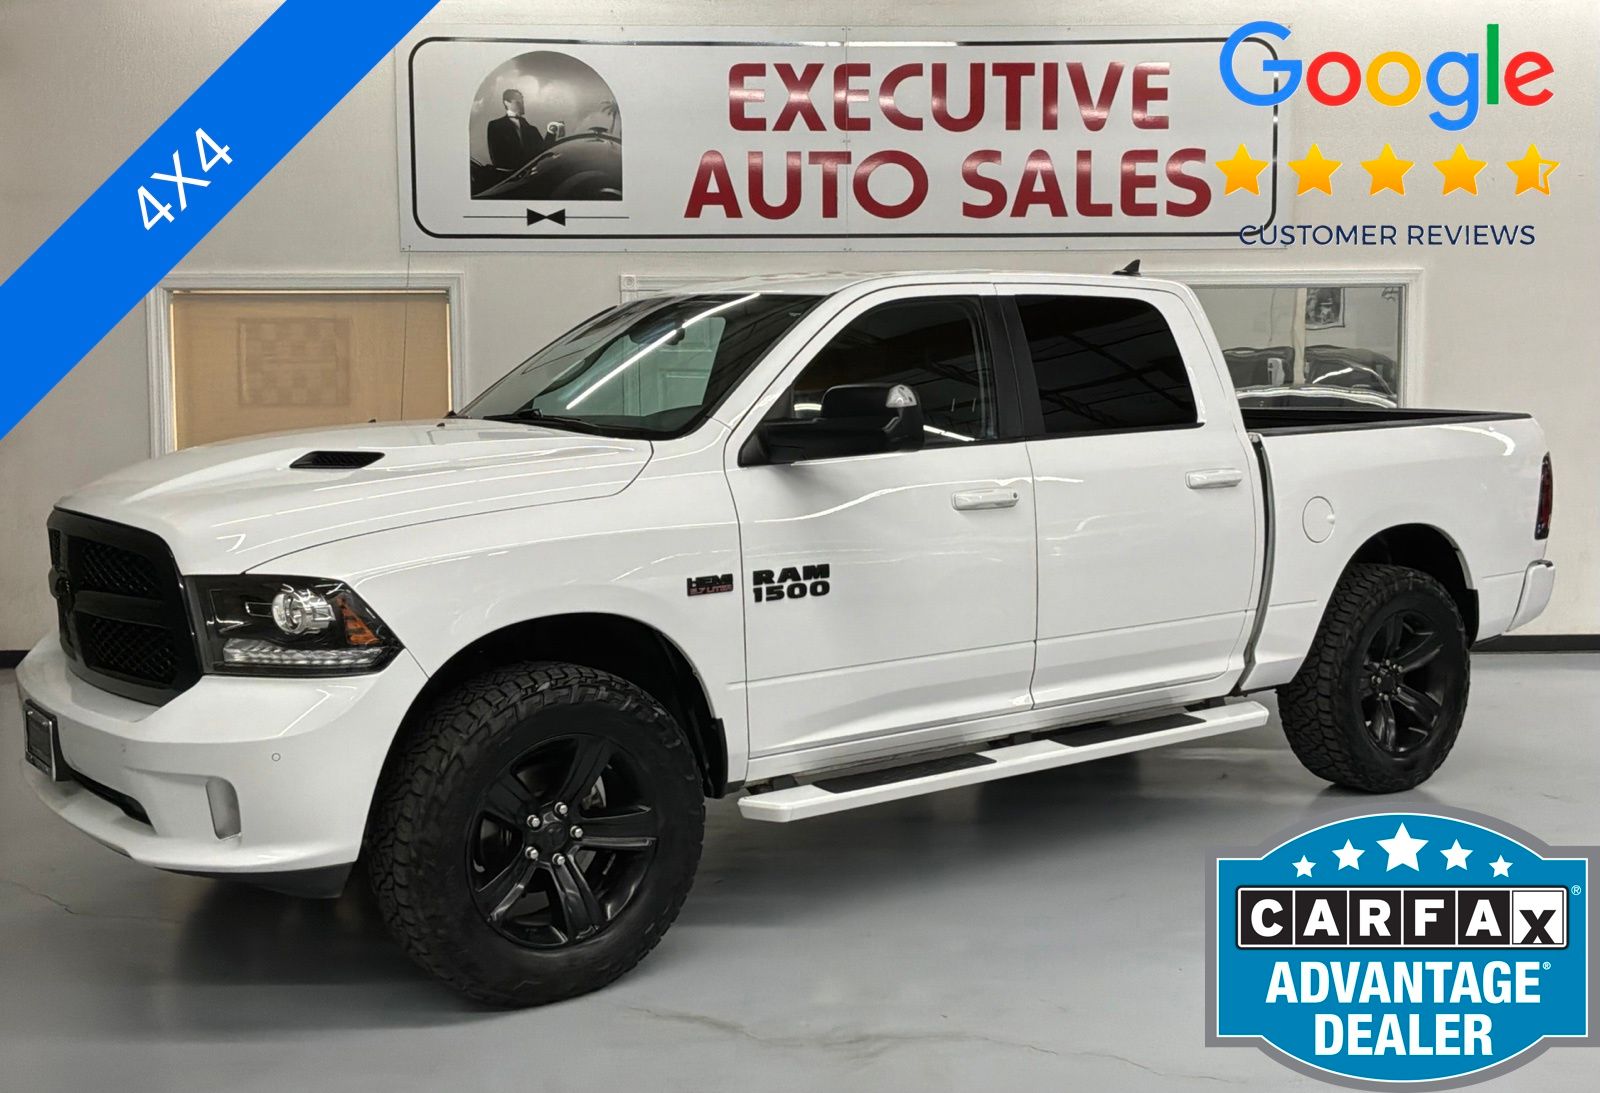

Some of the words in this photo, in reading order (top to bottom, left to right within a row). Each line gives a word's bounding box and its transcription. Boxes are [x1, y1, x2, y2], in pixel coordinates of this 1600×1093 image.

[728, 62, 1170, 132] EXECUTIVE
[684, 150, 929, 220] AUTO
[962, 148, 1212, 219] SALES
[687, 573, 733, 588] HEMI
[752, 563, 830, 586] RAM
[753, 580, 830, 603] 1500
